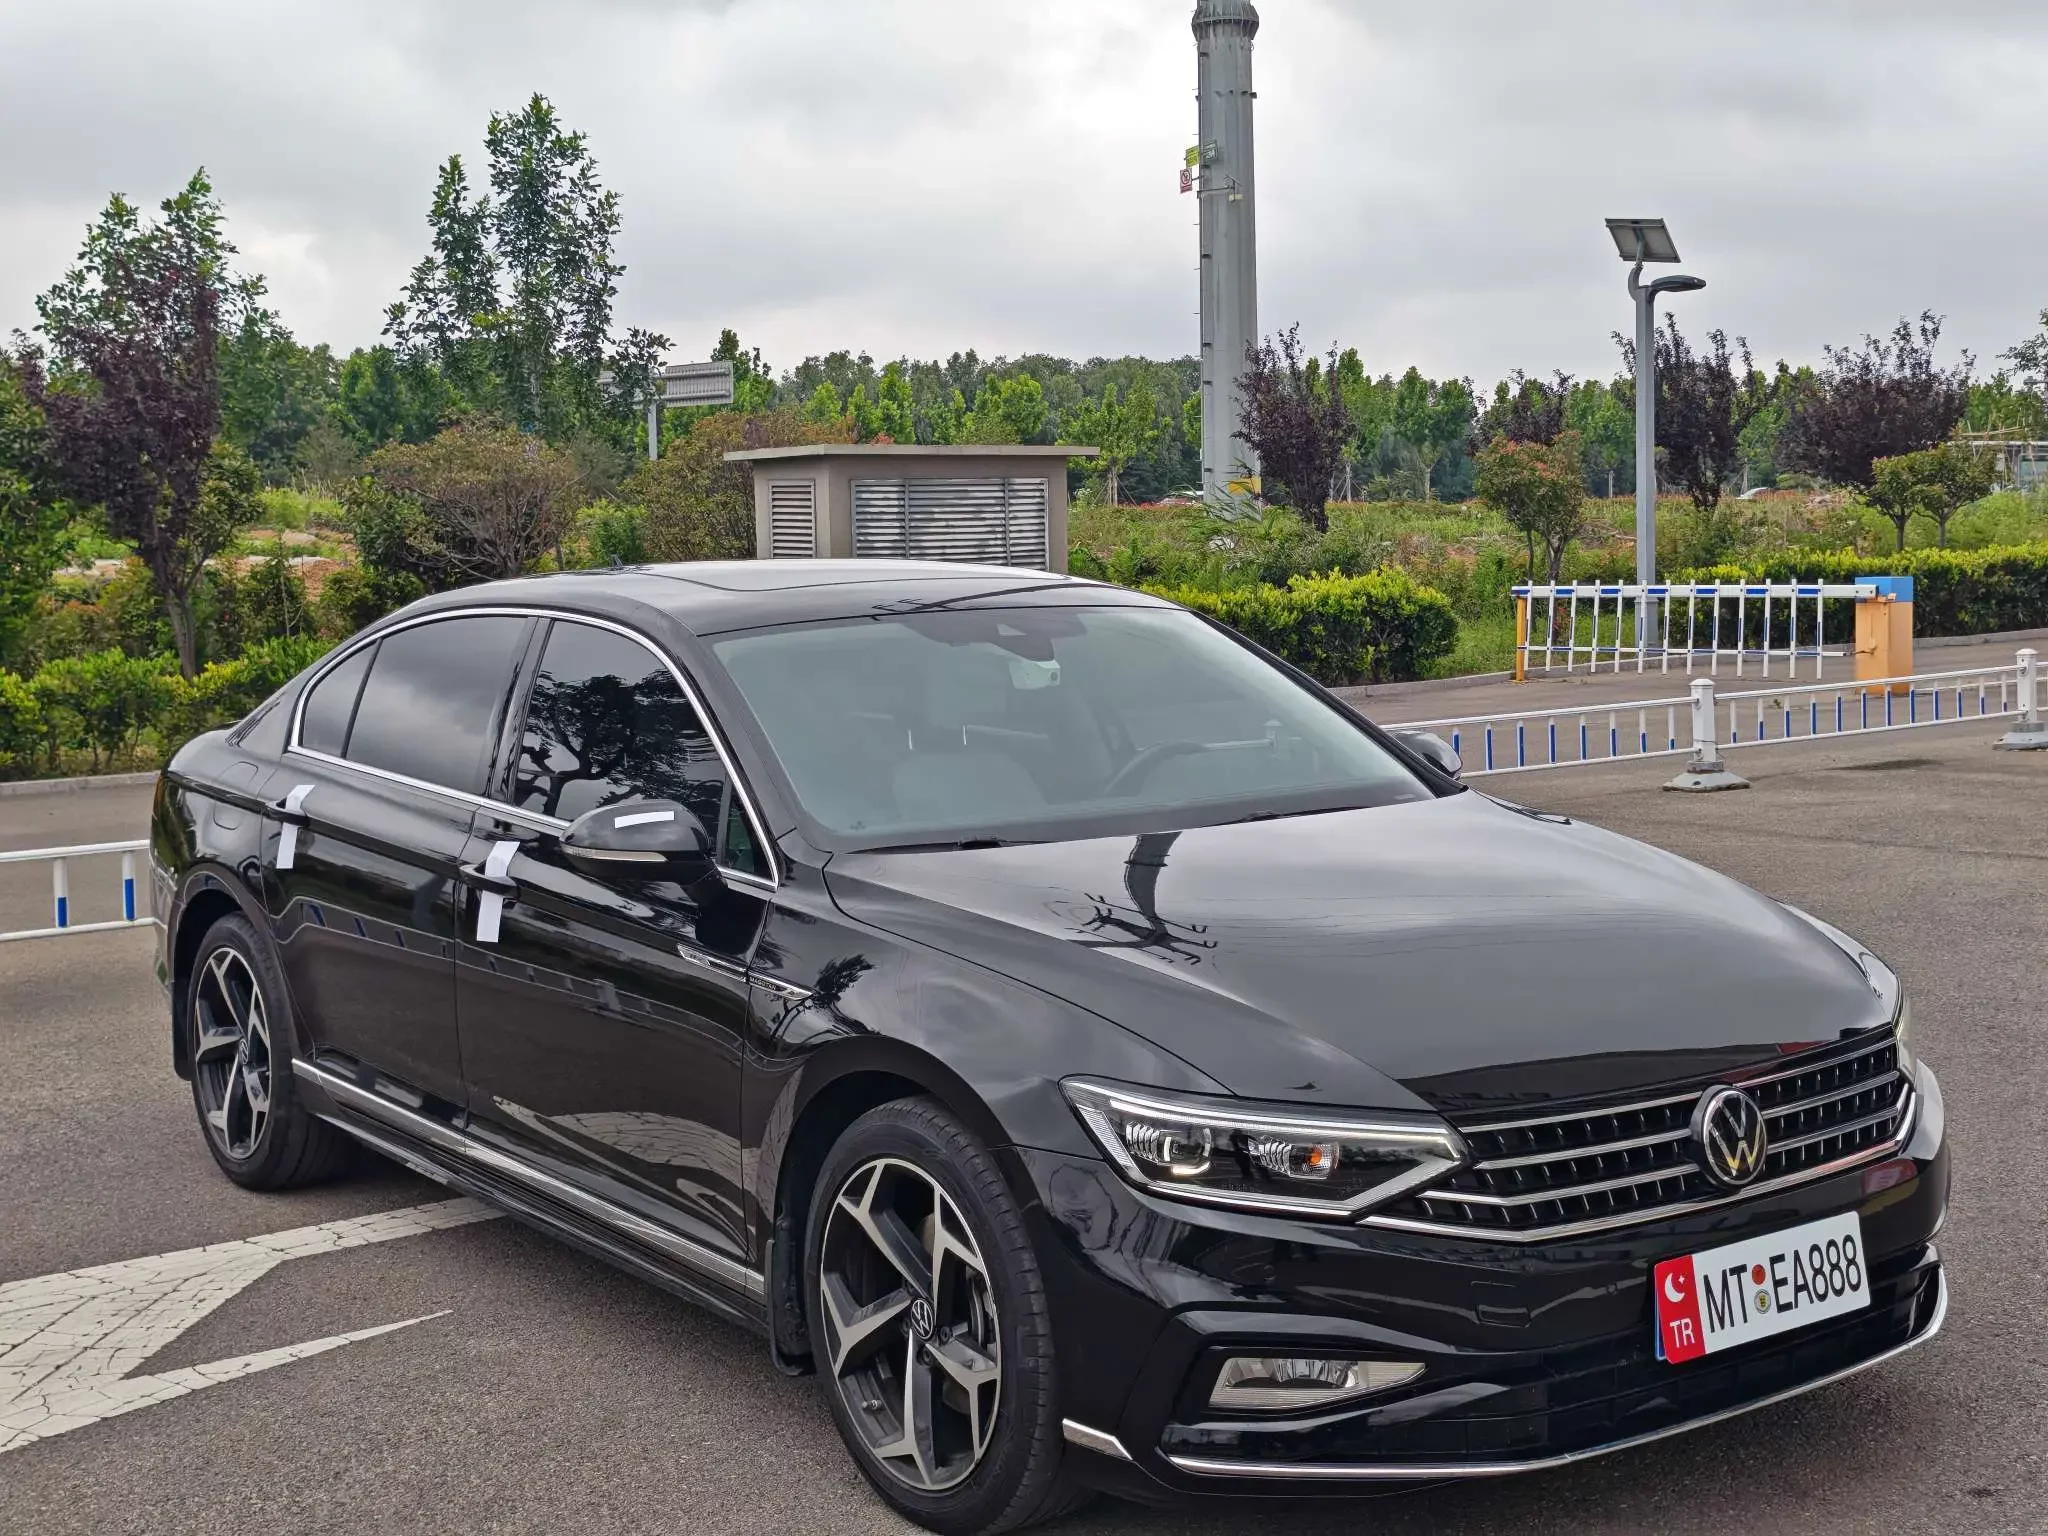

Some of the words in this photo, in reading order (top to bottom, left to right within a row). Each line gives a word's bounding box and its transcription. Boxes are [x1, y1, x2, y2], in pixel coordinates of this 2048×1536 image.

[1704, 1090, 1766, 1184] VW
[1703, 1263, 1748, 1333] MT
[1769, 1234, 1862, 1314] EA888
[1669, 1318, 1695, 1348] TR
